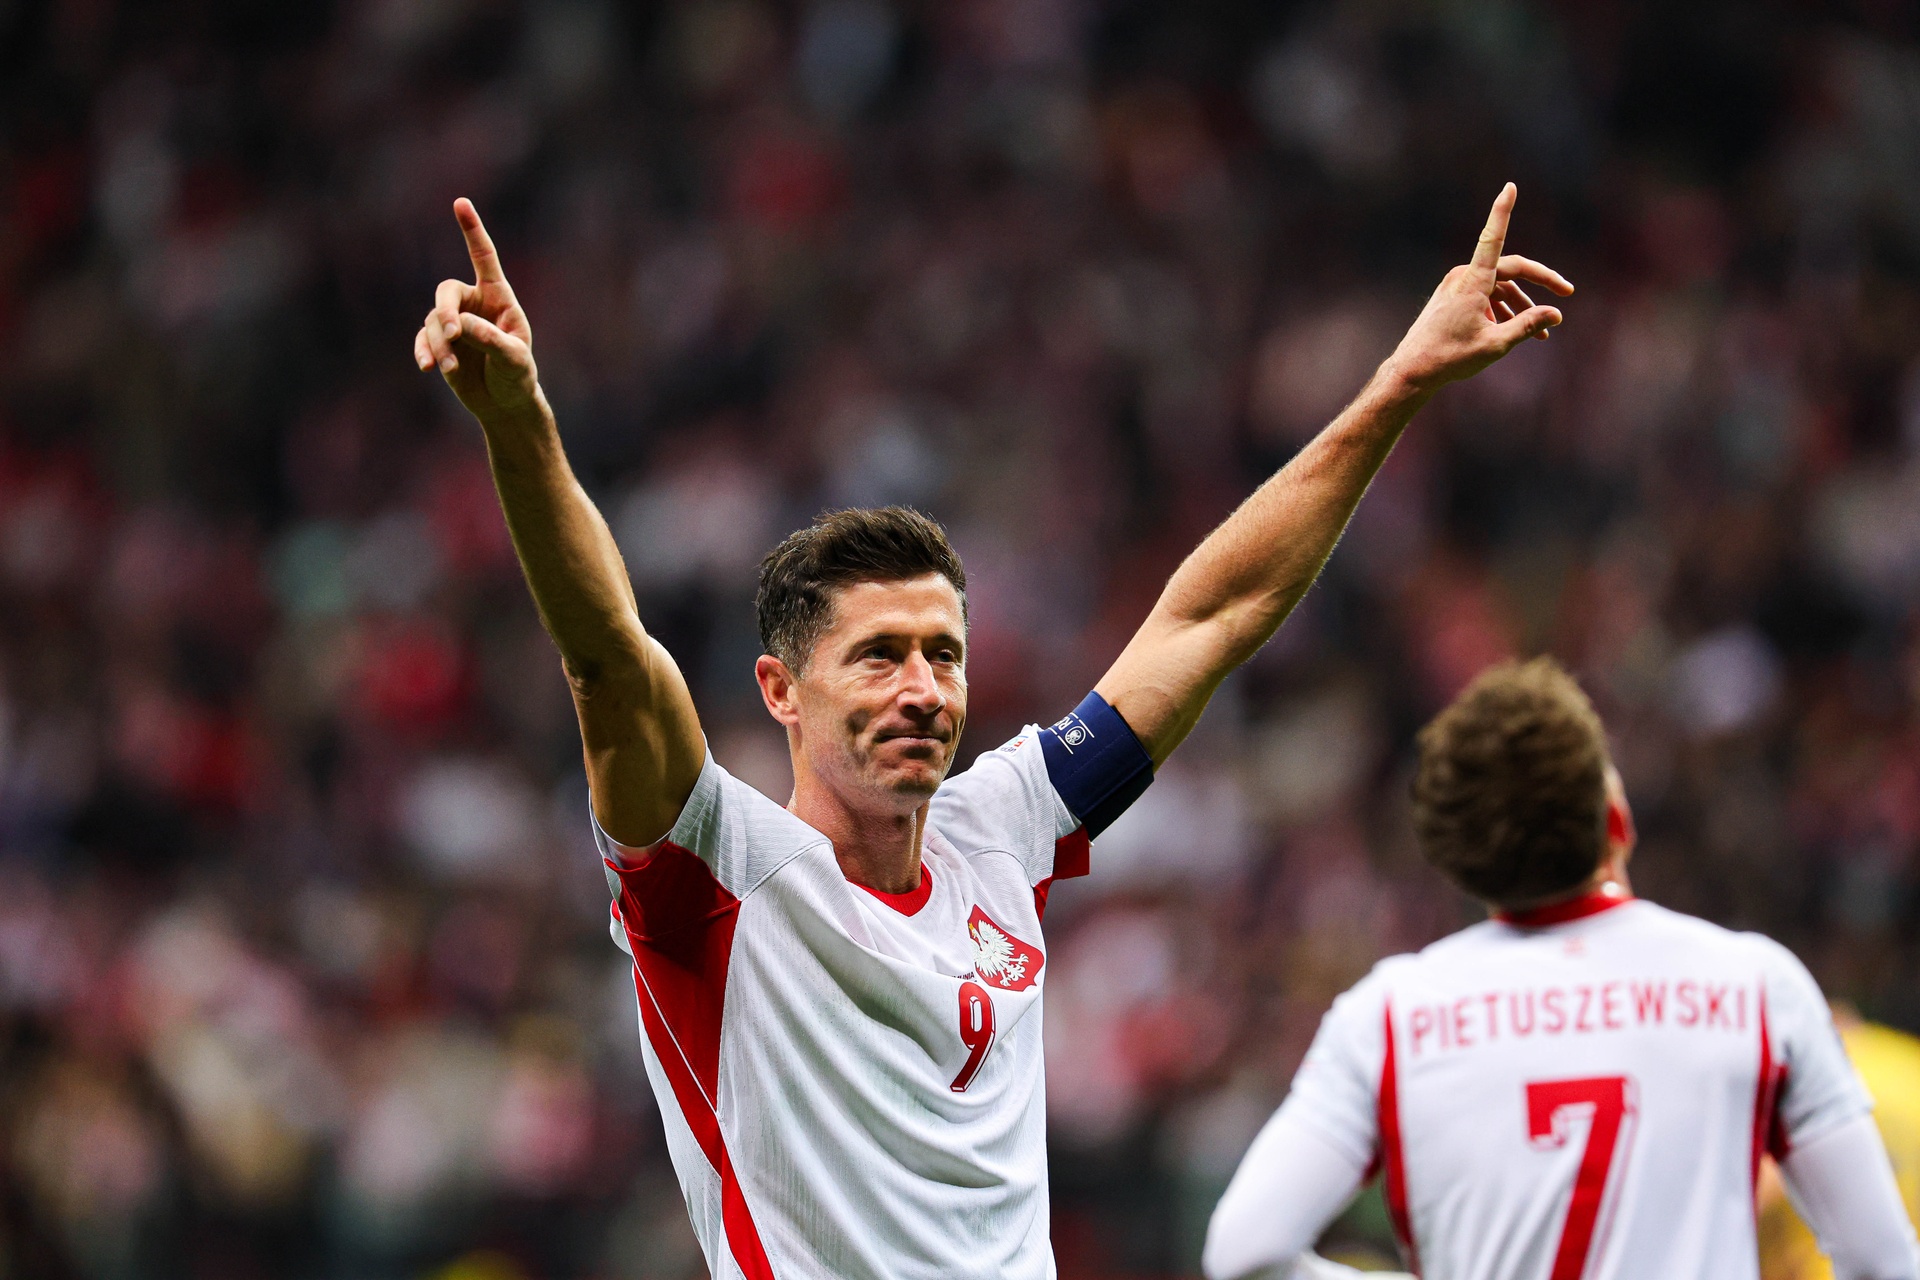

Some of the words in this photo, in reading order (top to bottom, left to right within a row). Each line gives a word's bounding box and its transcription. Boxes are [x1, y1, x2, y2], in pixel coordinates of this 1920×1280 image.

[949, 982, 996, 1092] 9
[1410, 981, 1747, 1055] PIETUSZEWSKI
[1525, 1075, 1639, 1280] 7
